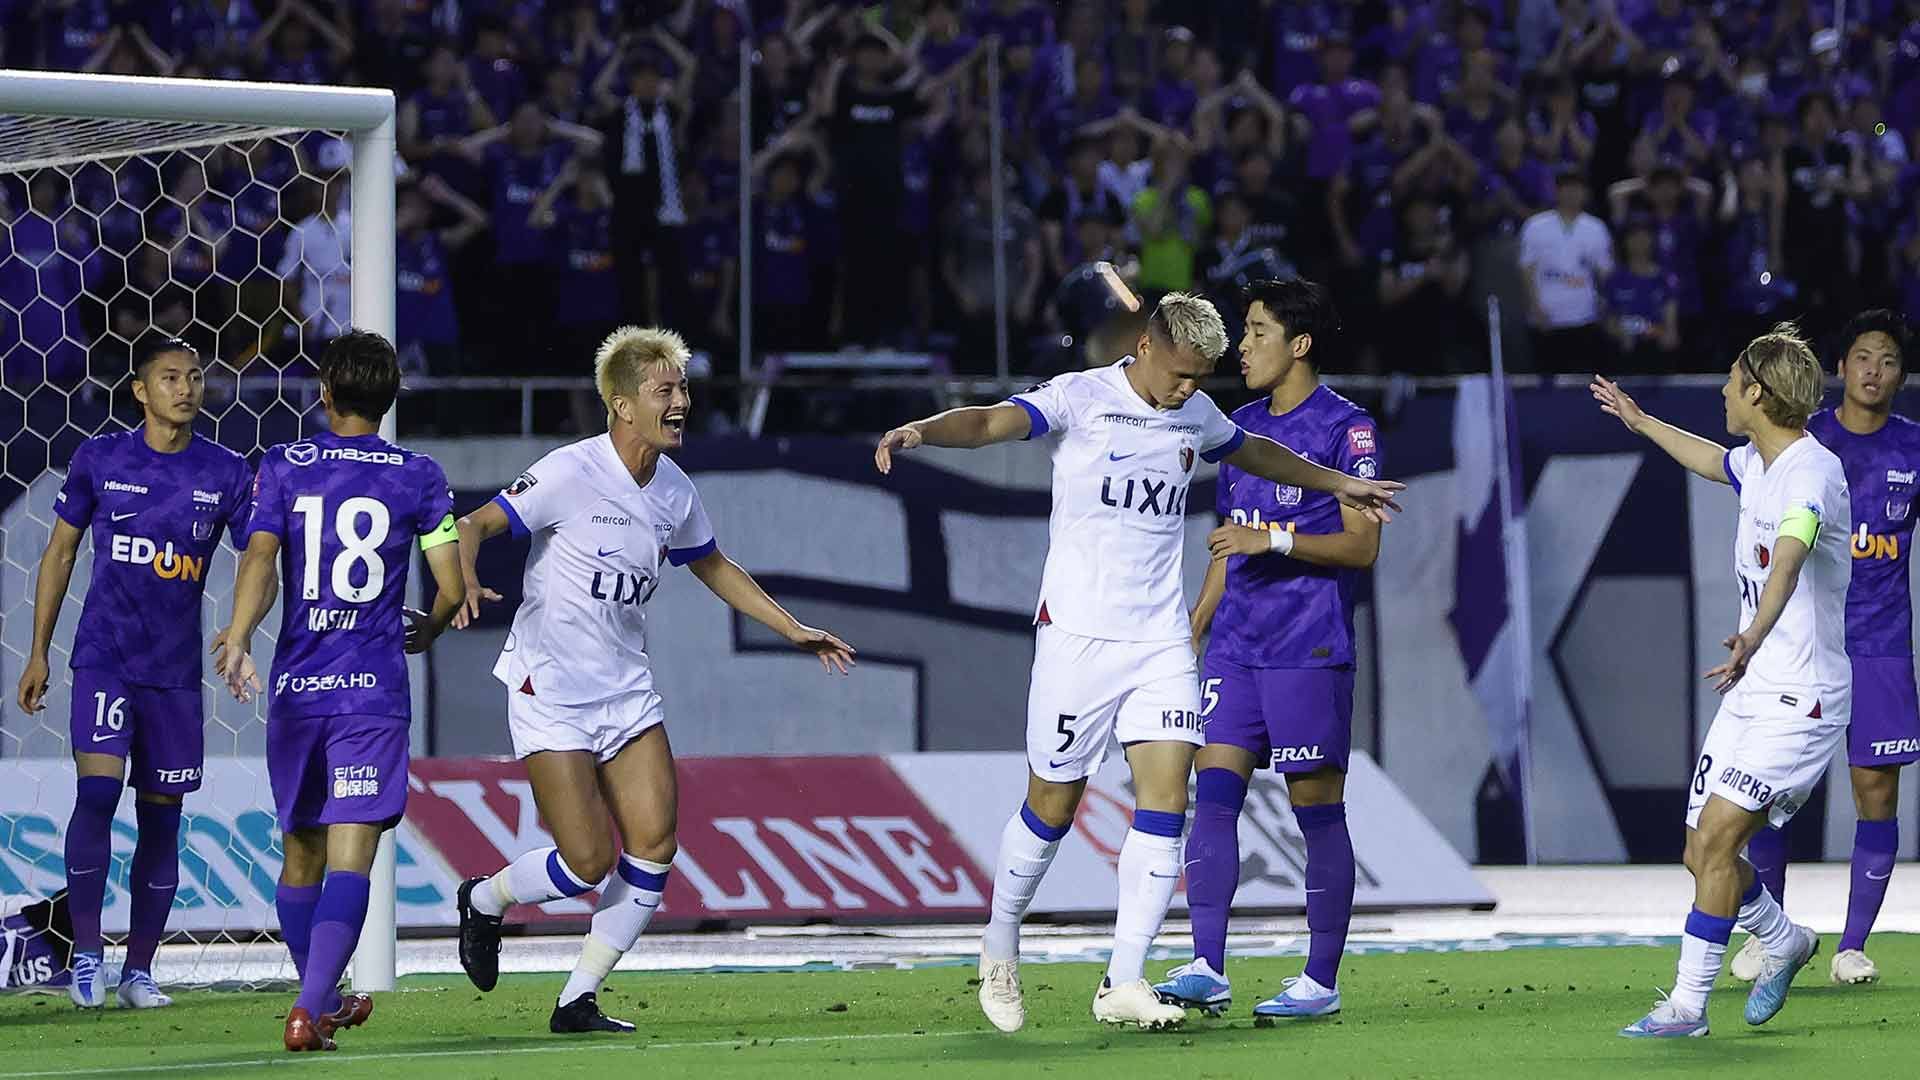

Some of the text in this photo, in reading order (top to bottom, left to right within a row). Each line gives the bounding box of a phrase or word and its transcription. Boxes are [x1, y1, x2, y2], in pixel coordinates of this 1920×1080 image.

[1104, 414, 1147, 428] mercari
[1352, 430, 1371, 442] you
[1357, 440, 1374, 449] me
[103, 480, 149, 494] Hisense
[591, 514, 632, 527] mercari
[292, 496, 391, 603] 18
[94, 691, 127, 731] 16
[1056, 713, 1077, 752] 5
[1694, 753, 1713, 795] 8
[672, 816, 985, 910] LINE
